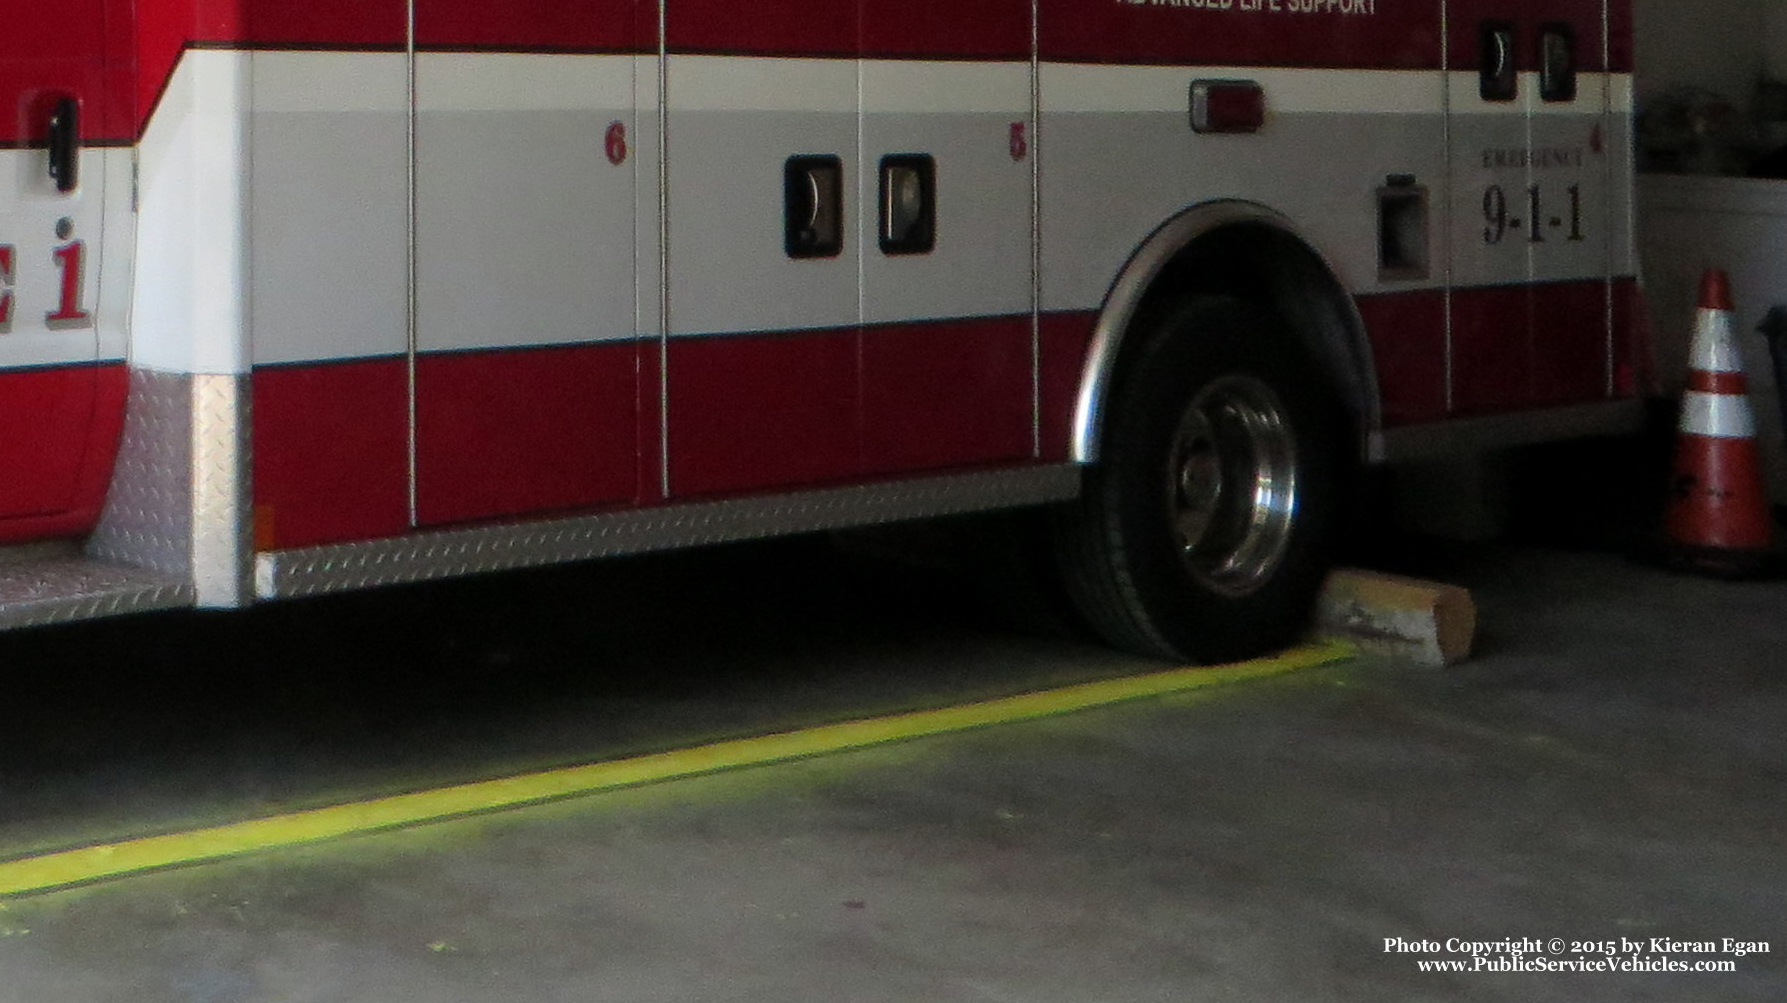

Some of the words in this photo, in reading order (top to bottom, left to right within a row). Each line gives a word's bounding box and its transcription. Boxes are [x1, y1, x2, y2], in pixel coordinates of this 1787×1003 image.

[604, 120, 626, 165] 6
[1009, 121, 1027, 161] 5
[1483, 183, 1586, 245] 9-1-1
